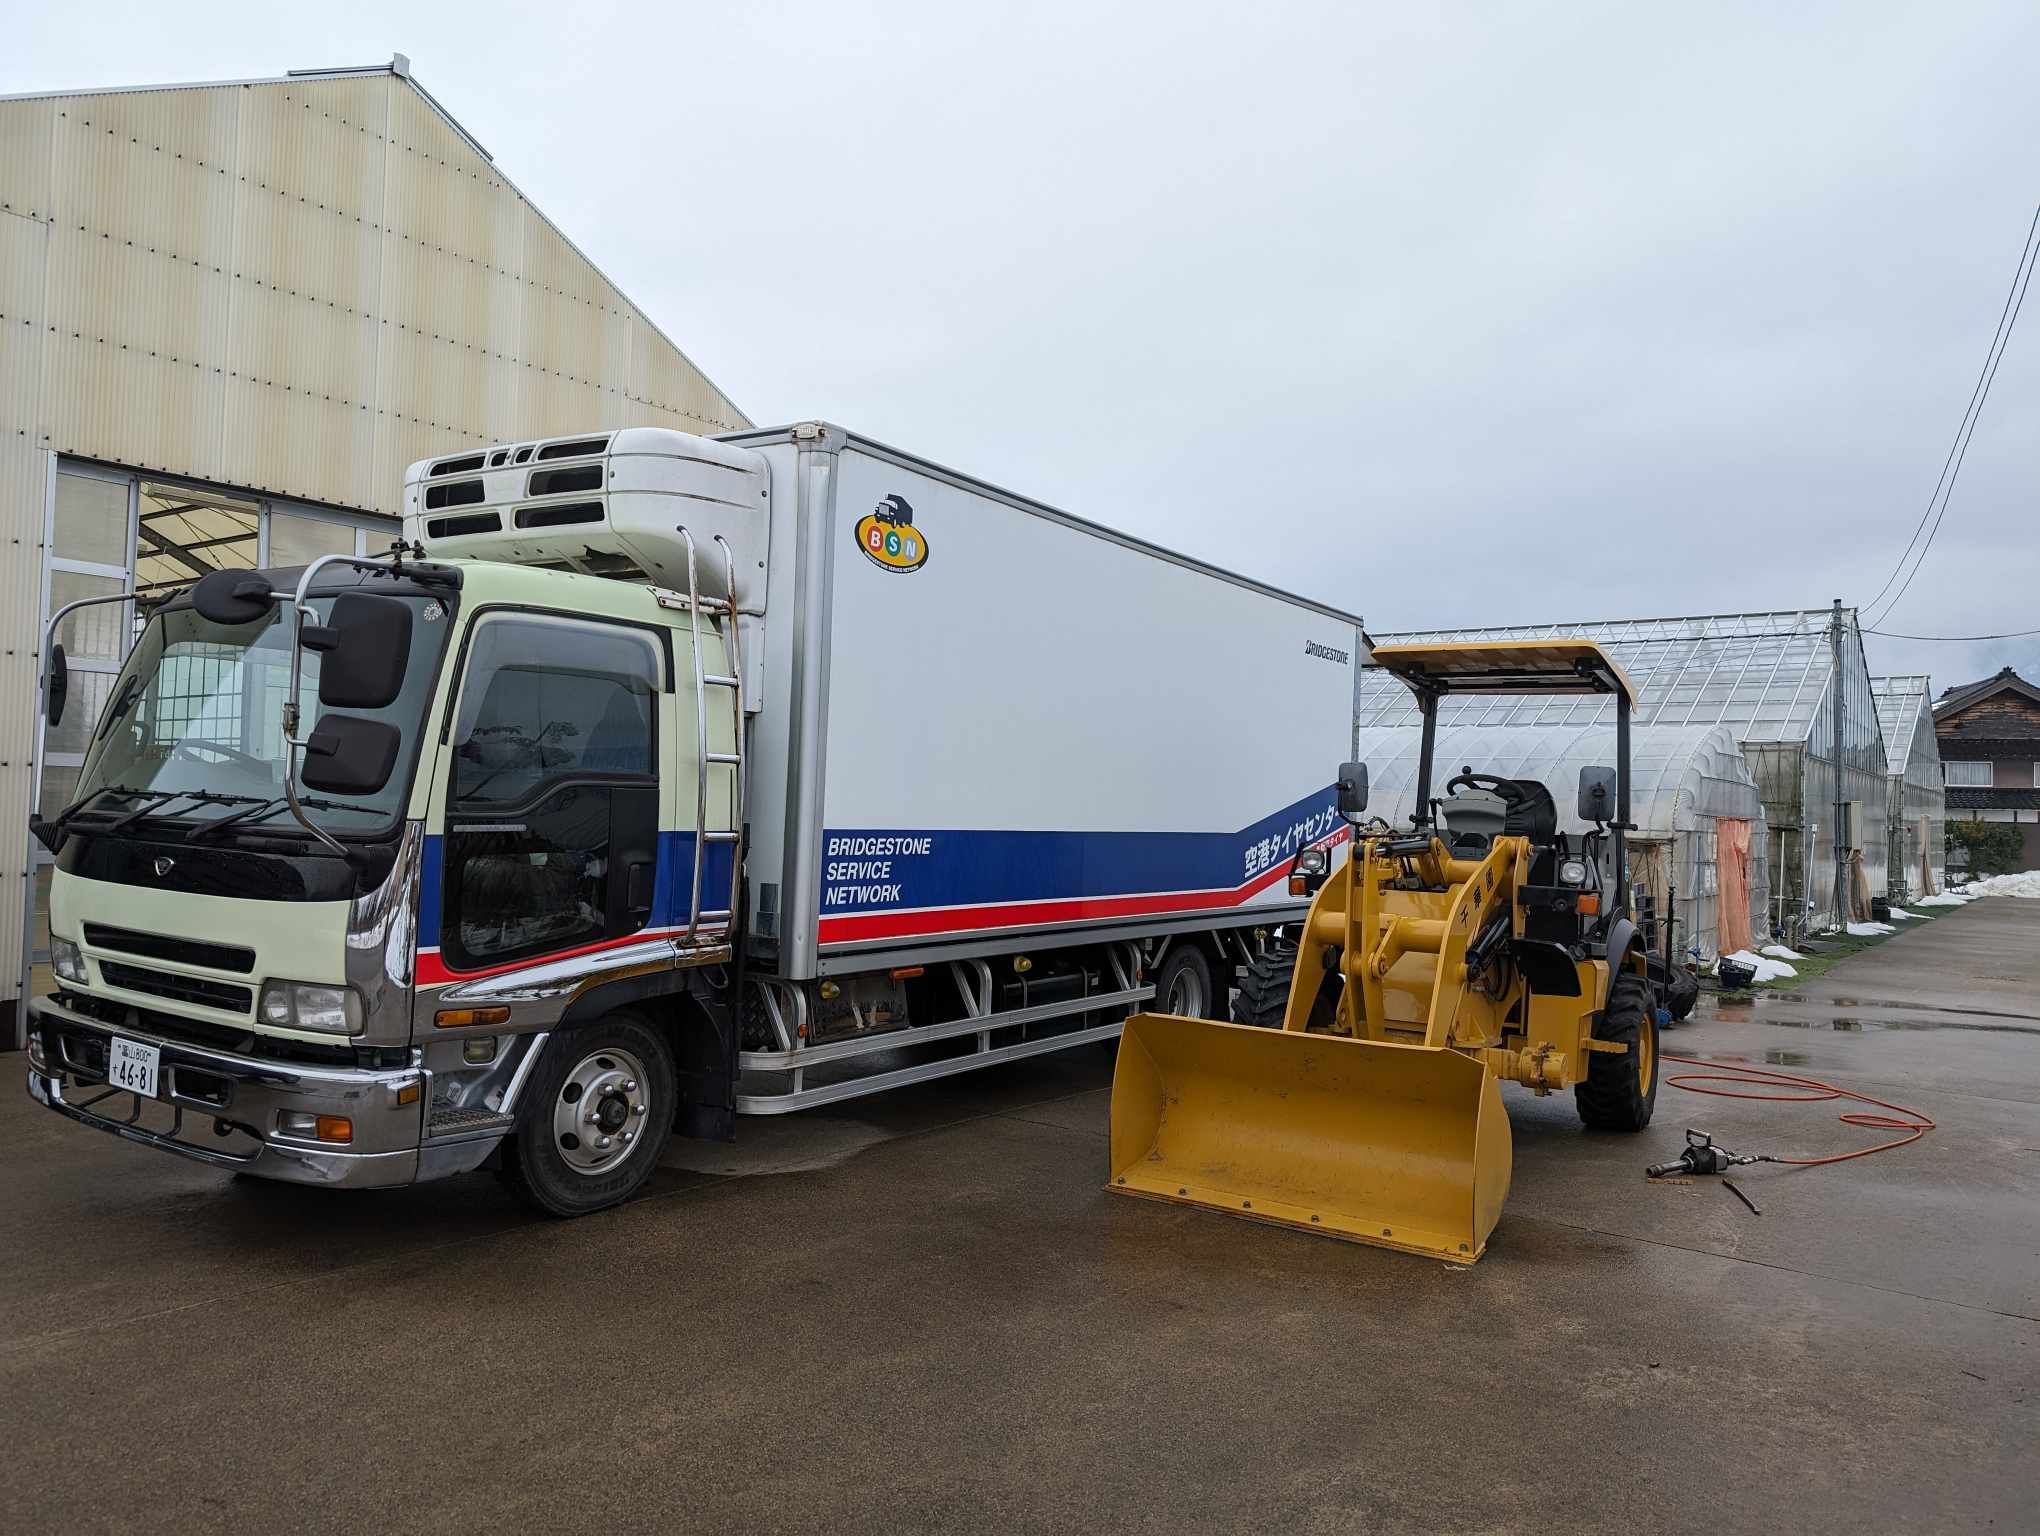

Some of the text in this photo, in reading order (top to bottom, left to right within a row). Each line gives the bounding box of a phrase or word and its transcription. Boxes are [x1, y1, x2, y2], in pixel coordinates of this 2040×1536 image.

[871, 530, 916, 558] BSN
[1304, 639, 1349, 665] BRIDGESTONE
[827, 837, 932, 856] BRIDGESTONE
[1244, 804, 1339, 878] 空港タイヤセンタ
[826, 861, 892, 881] SERVICE
[825, 884, 902, 906] NETWORK
